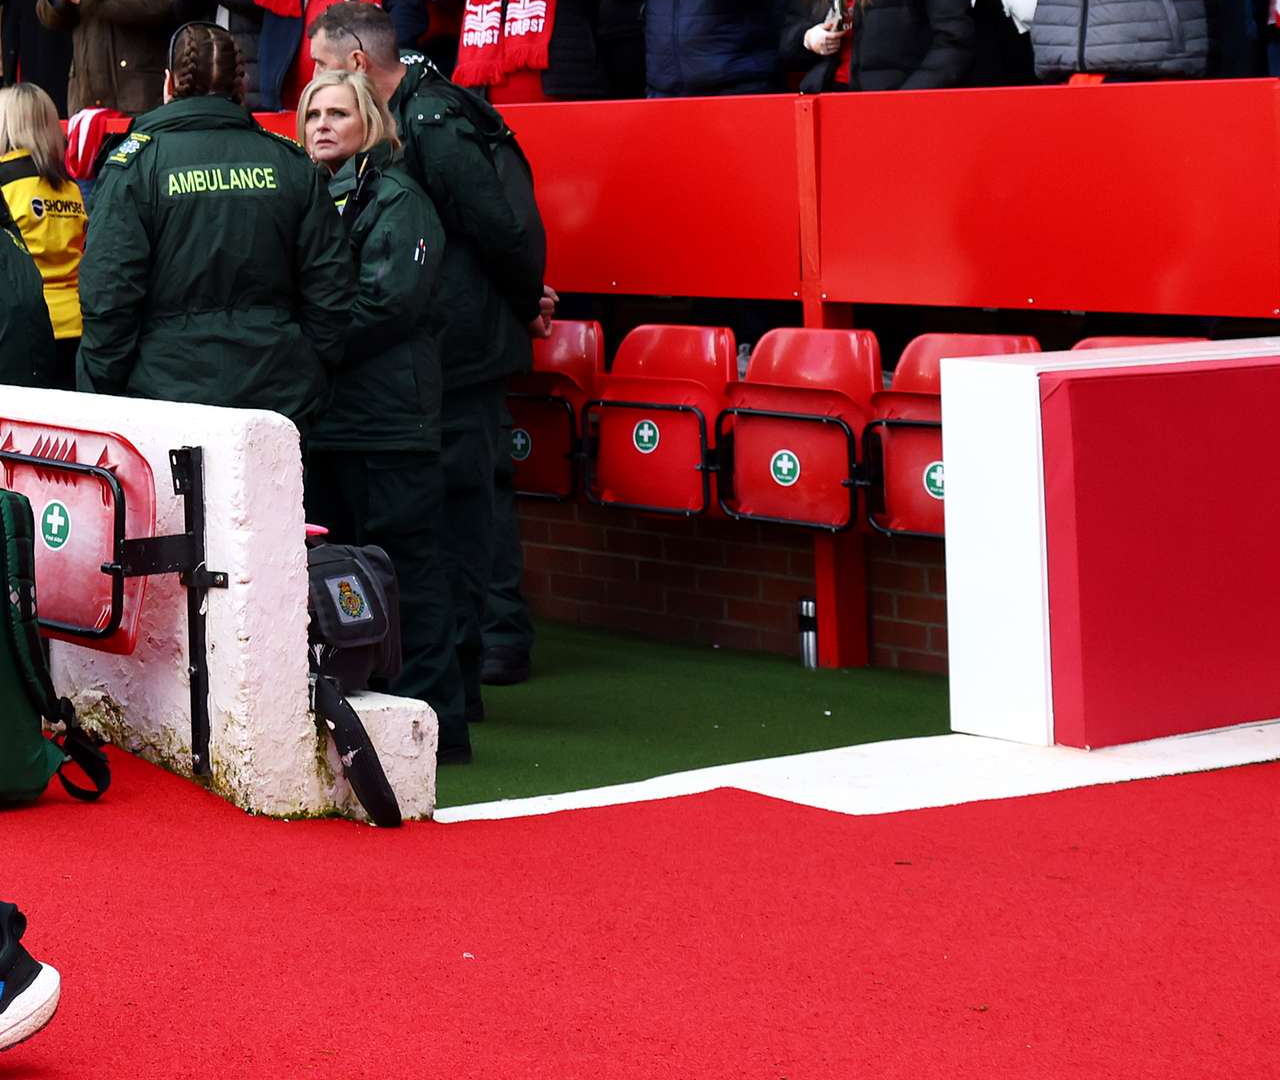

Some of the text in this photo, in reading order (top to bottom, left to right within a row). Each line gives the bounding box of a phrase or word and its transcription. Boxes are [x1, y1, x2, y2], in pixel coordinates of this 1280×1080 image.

[503, 18, 545, 37] FOREST
[463, 30, 500, 48] FOREST
[168, 168, 277, 196] AMBULANCE
